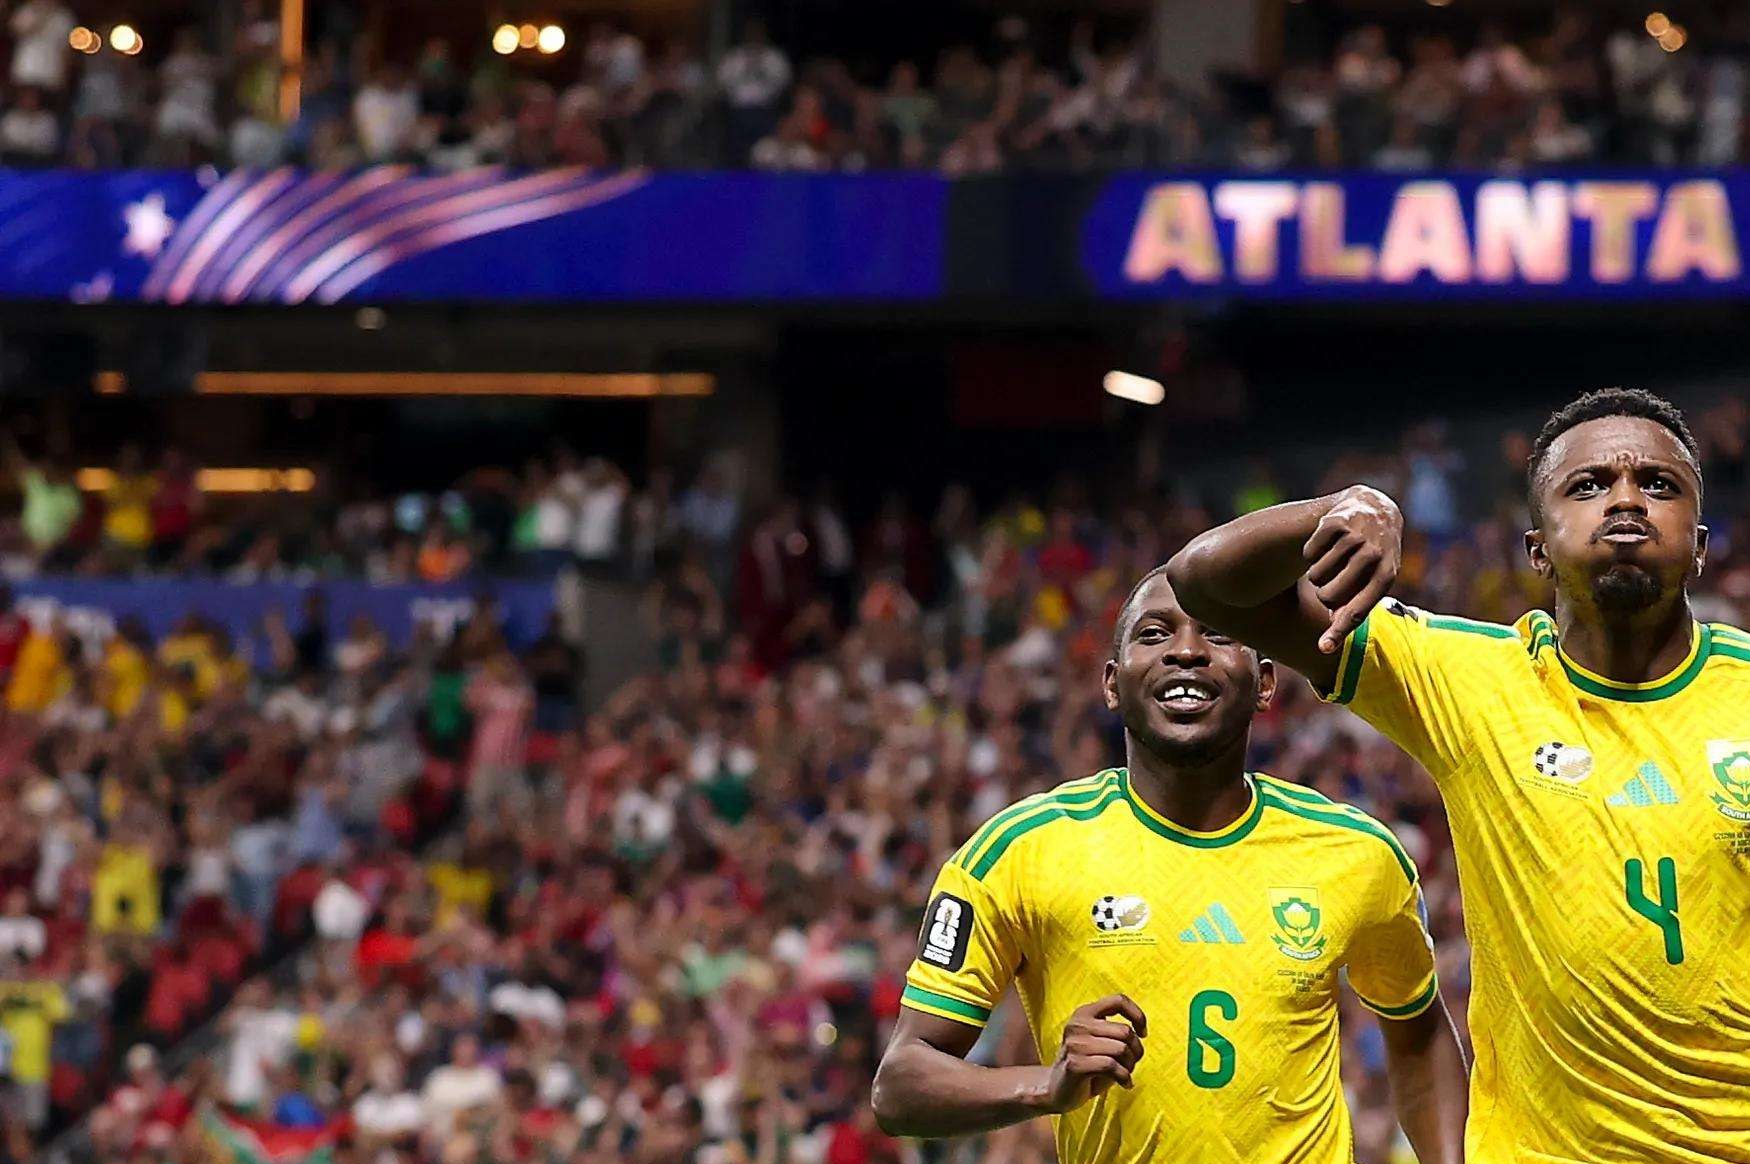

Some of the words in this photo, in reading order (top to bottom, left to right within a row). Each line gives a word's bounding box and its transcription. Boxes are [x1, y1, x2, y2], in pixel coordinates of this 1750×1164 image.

[1123, 180, 1741, 284] ATLANTA
[1625, 857, 1684, 966] 4
[1187, 989, 1238, 1089] 6
